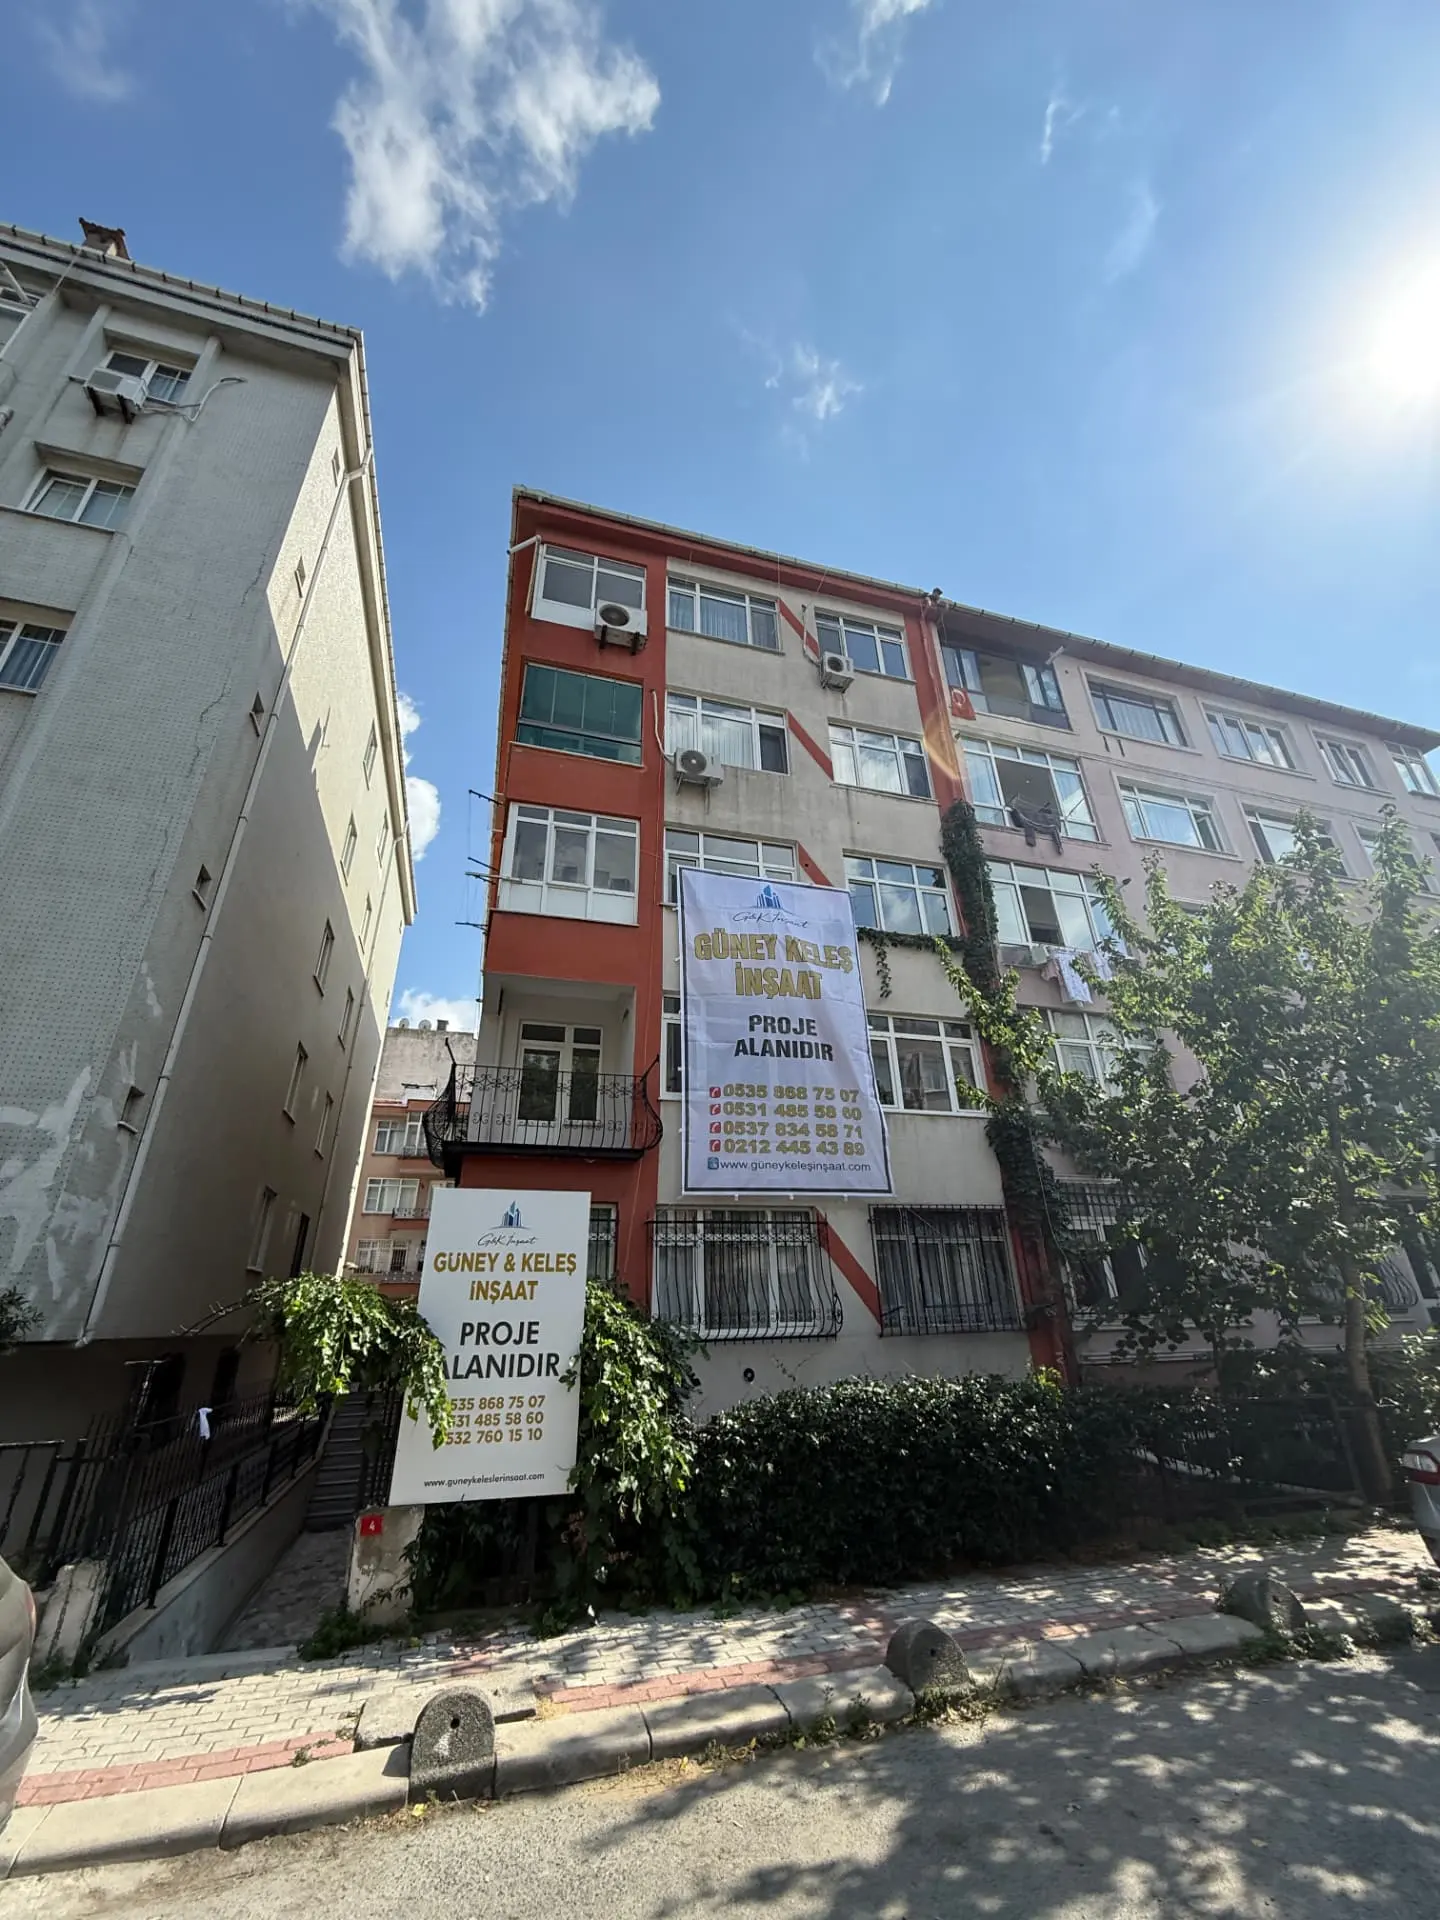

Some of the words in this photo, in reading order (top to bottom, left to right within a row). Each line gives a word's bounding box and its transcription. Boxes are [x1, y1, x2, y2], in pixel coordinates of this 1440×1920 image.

[693, 927, 778, 960] GÜNEY
[785, 934, 854, 974] KELEŞ
[734, 961, 823, 1000] İNŞAAT
[748, 1014, 818, 1036] PROJE
[734, 1037, 833, 1062] ALANIDIR
[723, 1083, 768, 1098] 0535
[812, 1086, 835, 1101] 75
[839, 1088, 859, 1103] 07
[723, 1101, 767, 1117] 0531
[774, 1103, 809, 1118] 485
[723, 1120, 770, 1136] 0537
[843, 1124, 862, 1139] 71
[724, 1138, 771, 1154] 0212
[776, 1140, 811, 1155] 445
[816, 1140, 839, 1155] 43
[433, 1252, 500, 1273] GÜNEY
[504, 1252, 516, 1273] &
[521, 1252, 577, 1276] KELEŞ
[469, 1280, 539, 1304] İNŞAAT
[459, 1321, 540, 1346] PROJE
[450, 1397, 475, 1411] 535
[478, 1396, 505, 1410] 868
[508, 1395, 525, 1409] 75
[528, 1394, 546, 1408] 07
[474, 1412, 501, 1427] 485
[504, 1411, 522, 1426] 58
[526, 1410, 544, 1425] 60
[446, 1430, 472, 1445] 532
[476, 1429, 504, 1444] 760
[508, 1428, 523, 1442] 15
[527, 1427, 543, 1441] 10
[368, 1520, 376, 1532] 4
